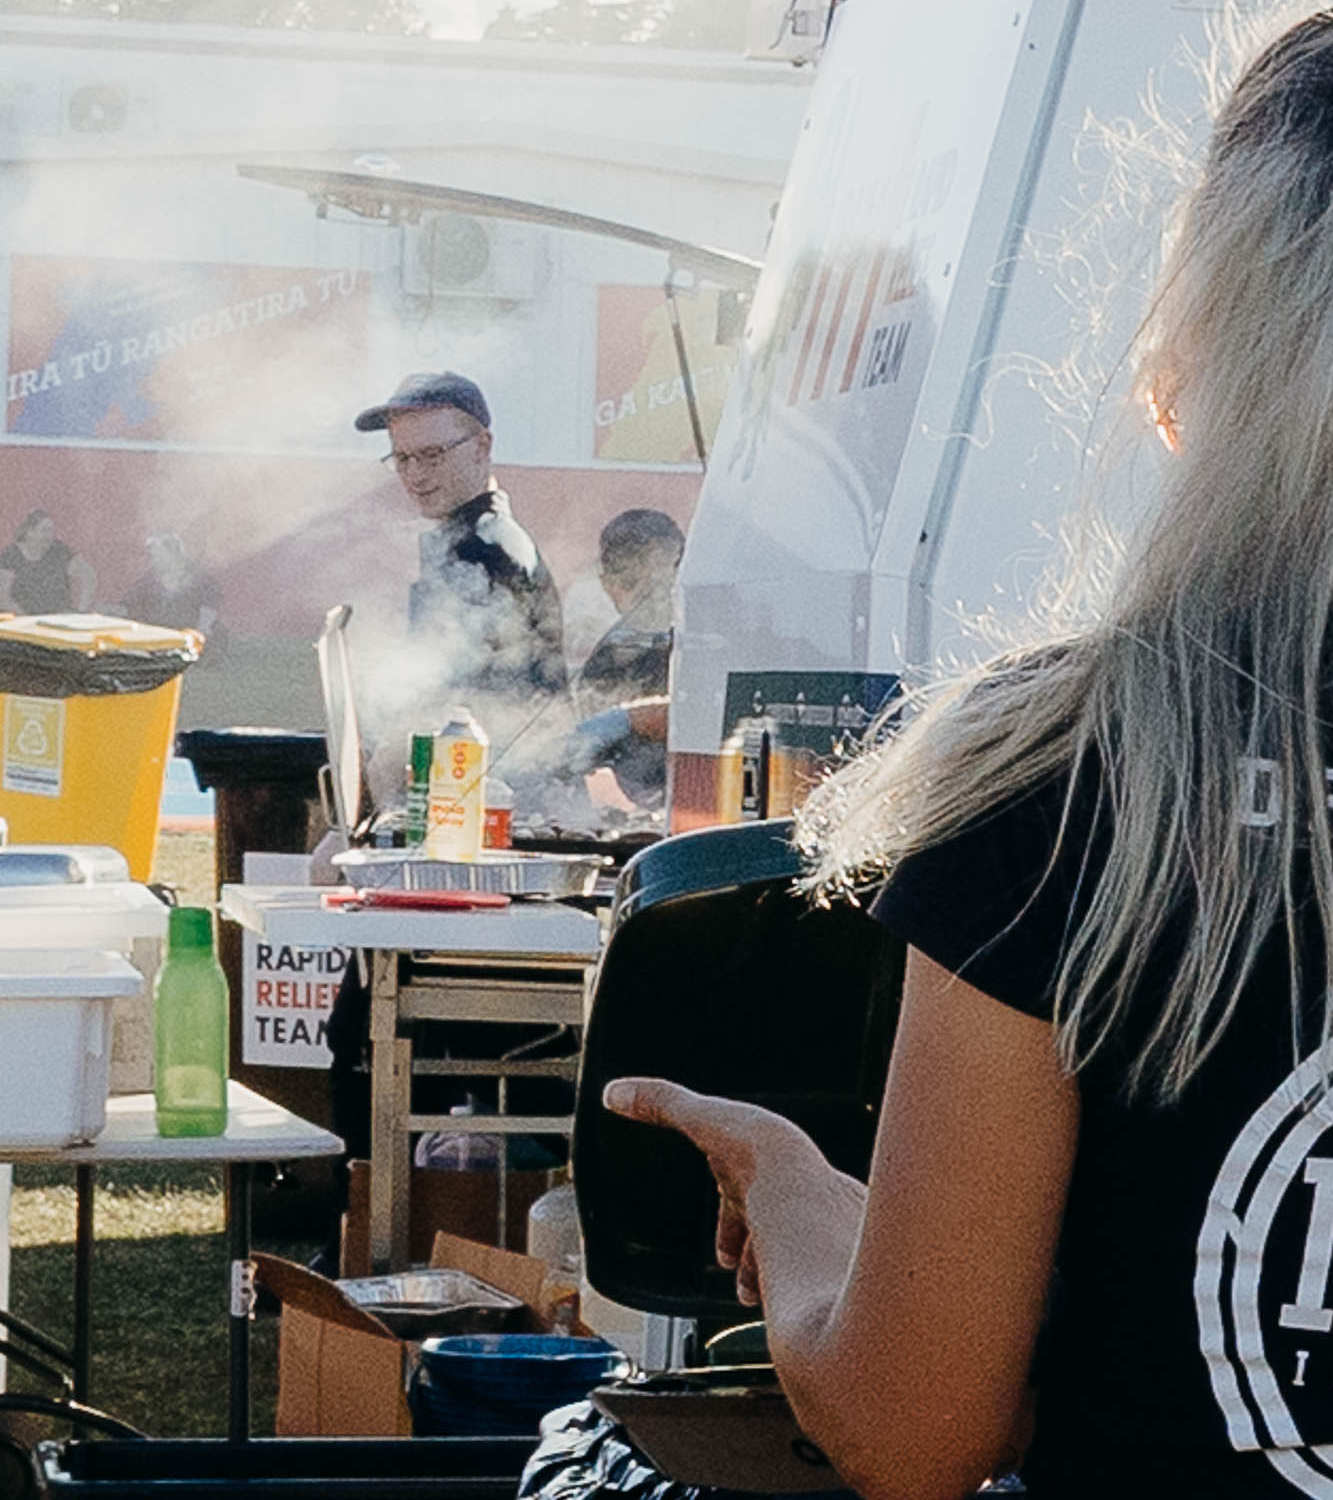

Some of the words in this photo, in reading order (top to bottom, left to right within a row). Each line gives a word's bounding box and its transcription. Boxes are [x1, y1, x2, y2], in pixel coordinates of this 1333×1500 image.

[120, 284, 309, 365] RANGATIRA
[256, 944, 346, 974] RAPID
[1293, 1350, 1311, 1388] I
